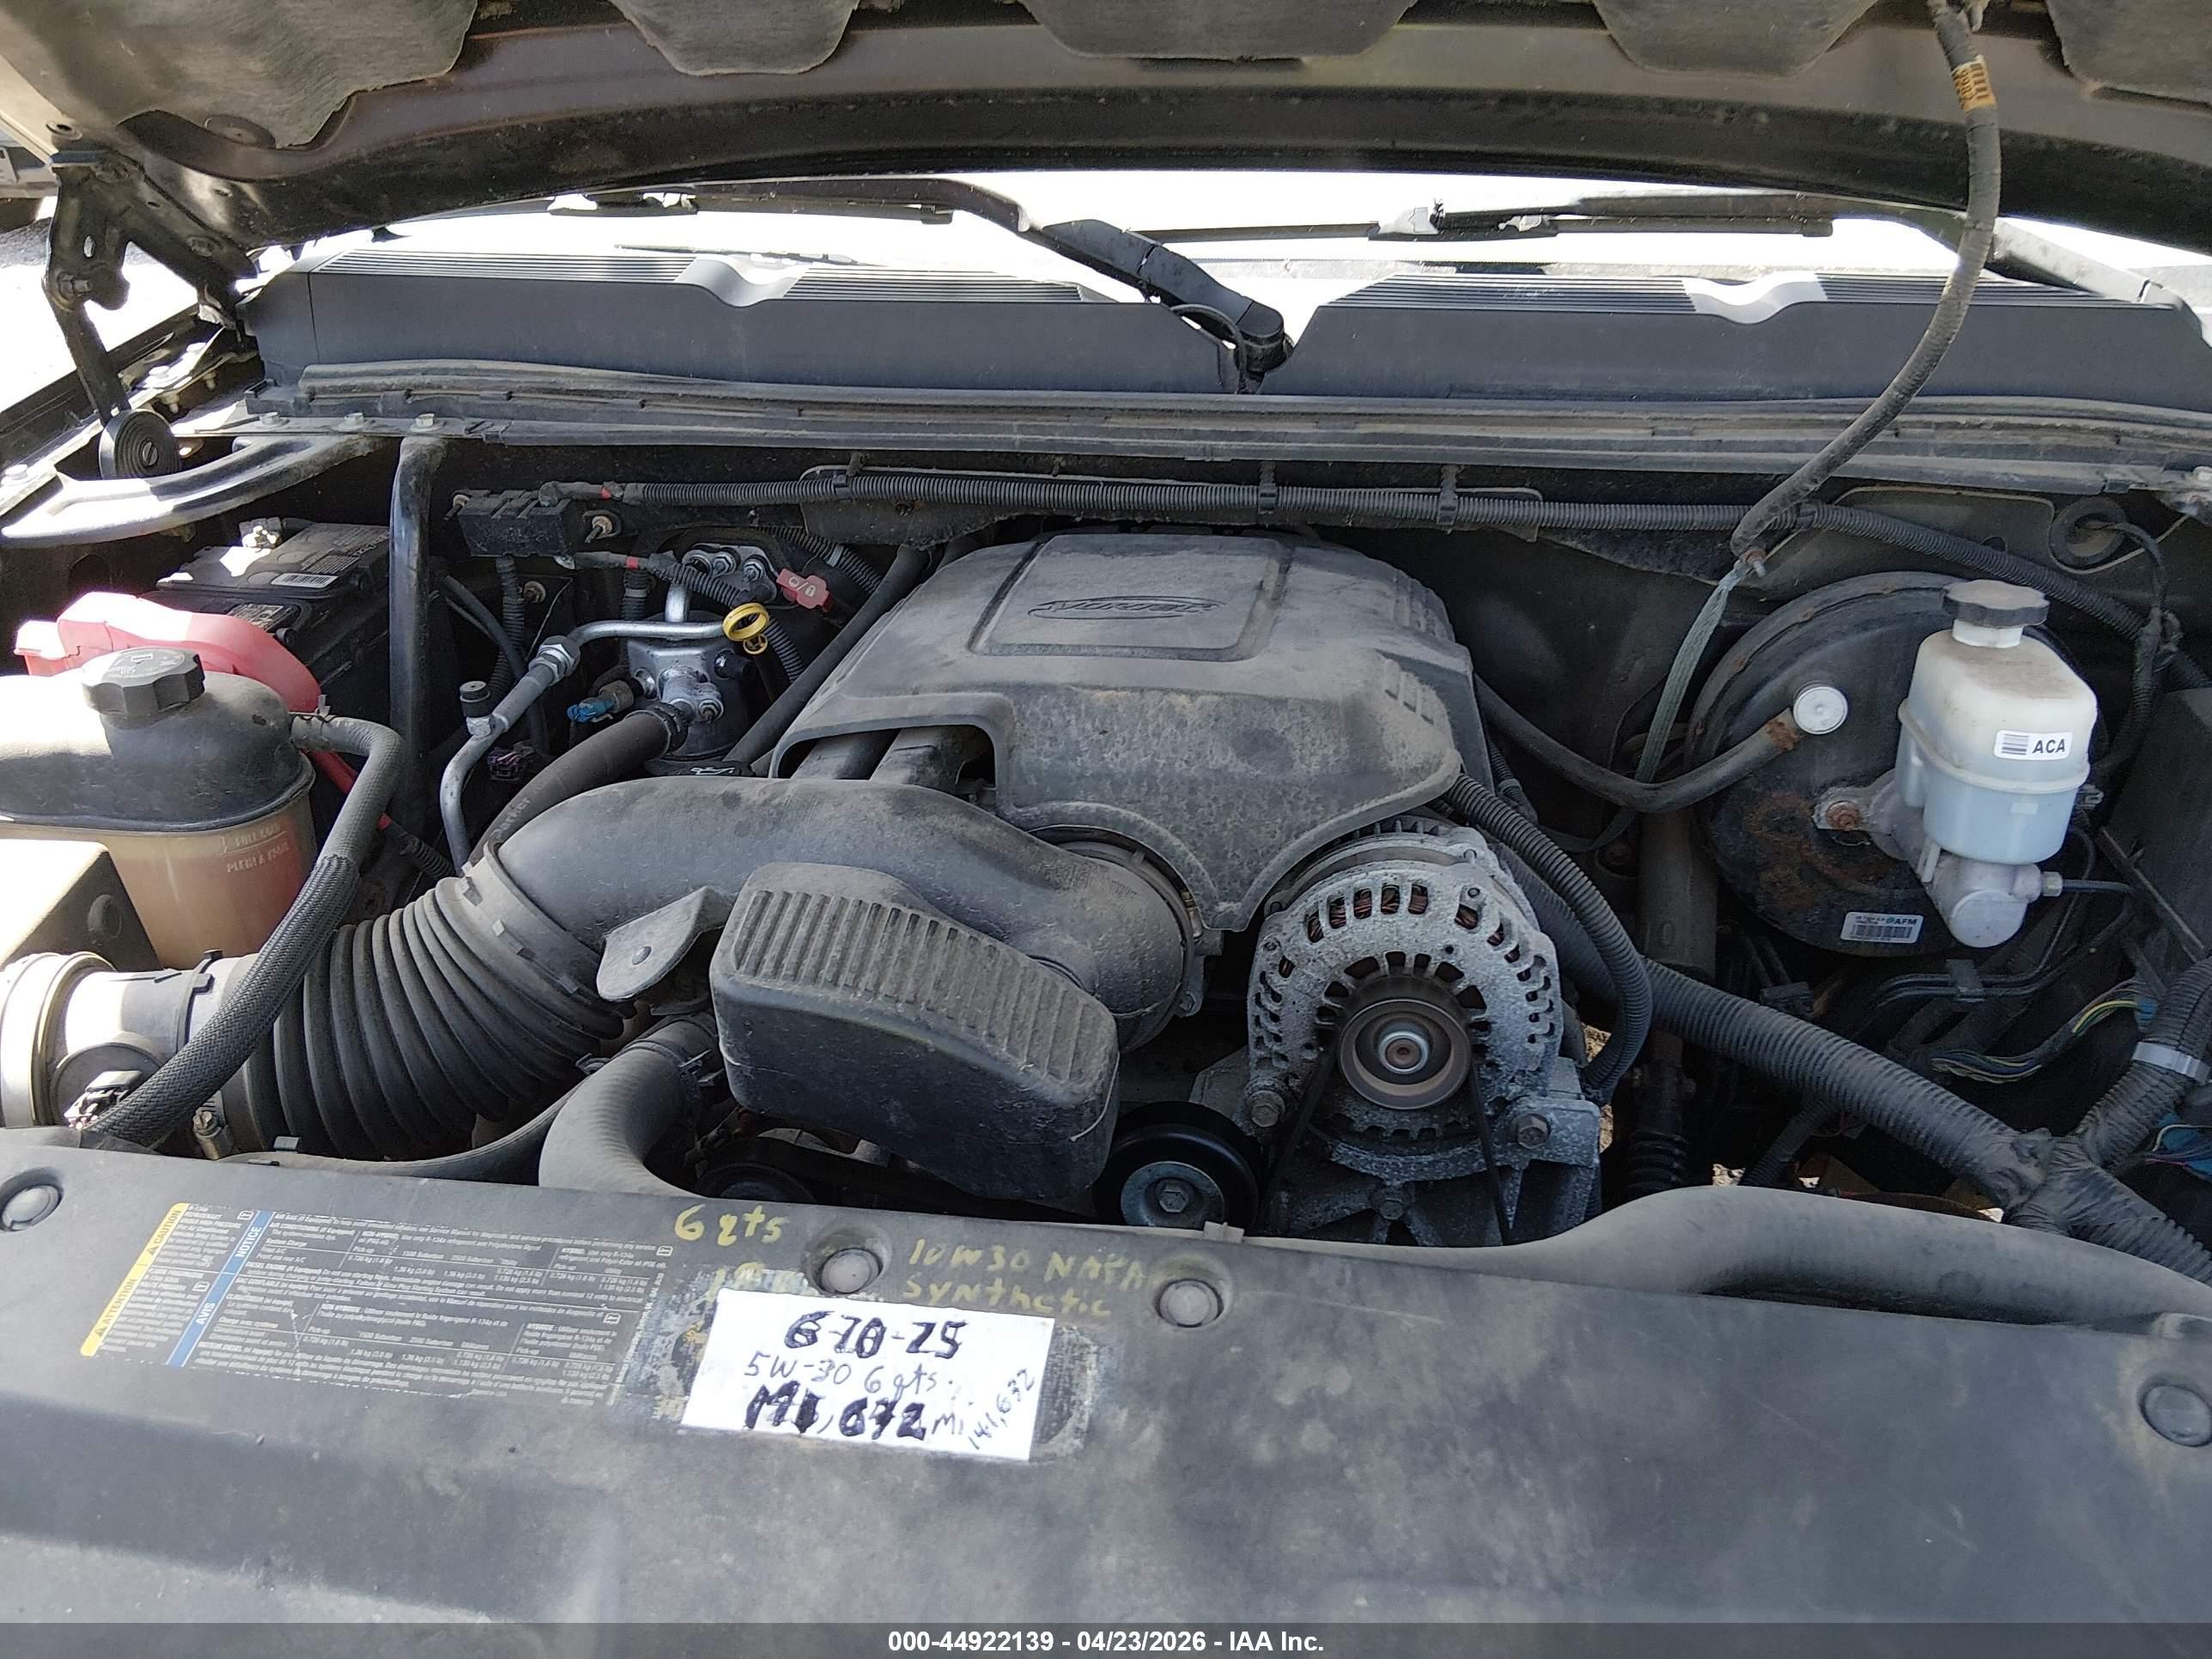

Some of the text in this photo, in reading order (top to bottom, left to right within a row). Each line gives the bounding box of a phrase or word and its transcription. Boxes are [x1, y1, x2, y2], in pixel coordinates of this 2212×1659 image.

[2032, 738, 2065, 754] ACA
[153, 1209, 182, 1245] CAUTION
[234, 1225, 263, 1259] NOTICE
[102, 1278, 138, 1322] ATTENTION
[195, 1301, 216, 1326] AVIS
[864, 1365, 884, 1394] 6
